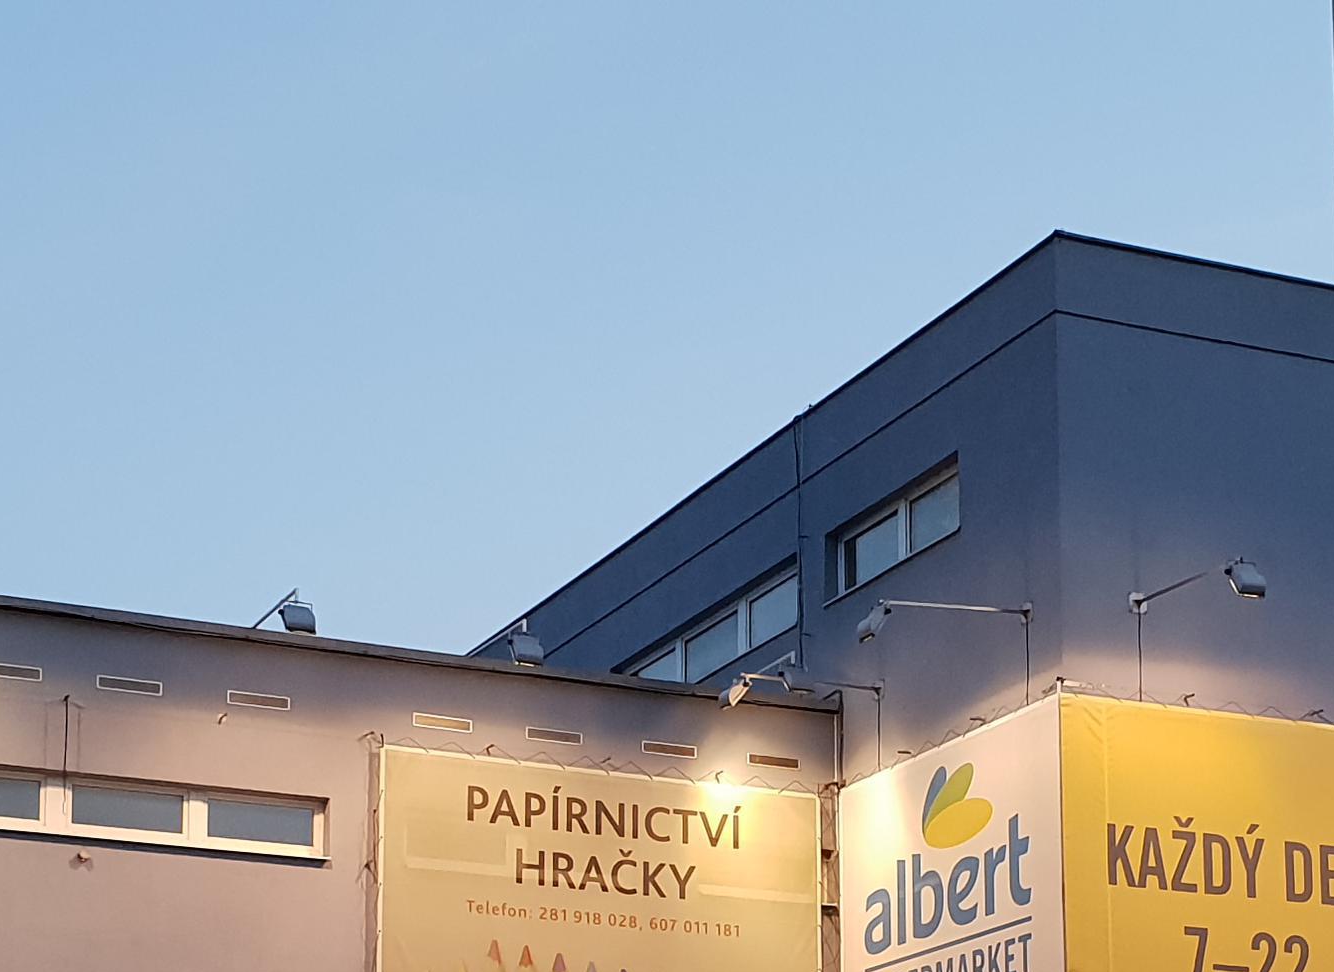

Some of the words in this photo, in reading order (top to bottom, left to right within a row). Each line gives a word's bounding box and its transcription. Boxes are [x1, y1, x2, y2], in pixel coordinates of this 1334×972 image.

[466, 785, 742, 850] PAPÍRNICTVÍ
[515, 848, 696, 900] HRAČKY
[865, 814, 1032, 955] albert
[1107, 816, 1265, 900] KAŽDÝ
[467, 899, 533, 919] Telefon:
[539, 906, 567, 922] 281
[573, 910, 601, 925] 918
[608, 913, 643, 931] 028,
[649, 917, 676, 932] 607
[683, 920, 708, 935] 011
[715, 923, 740, 937] 181
